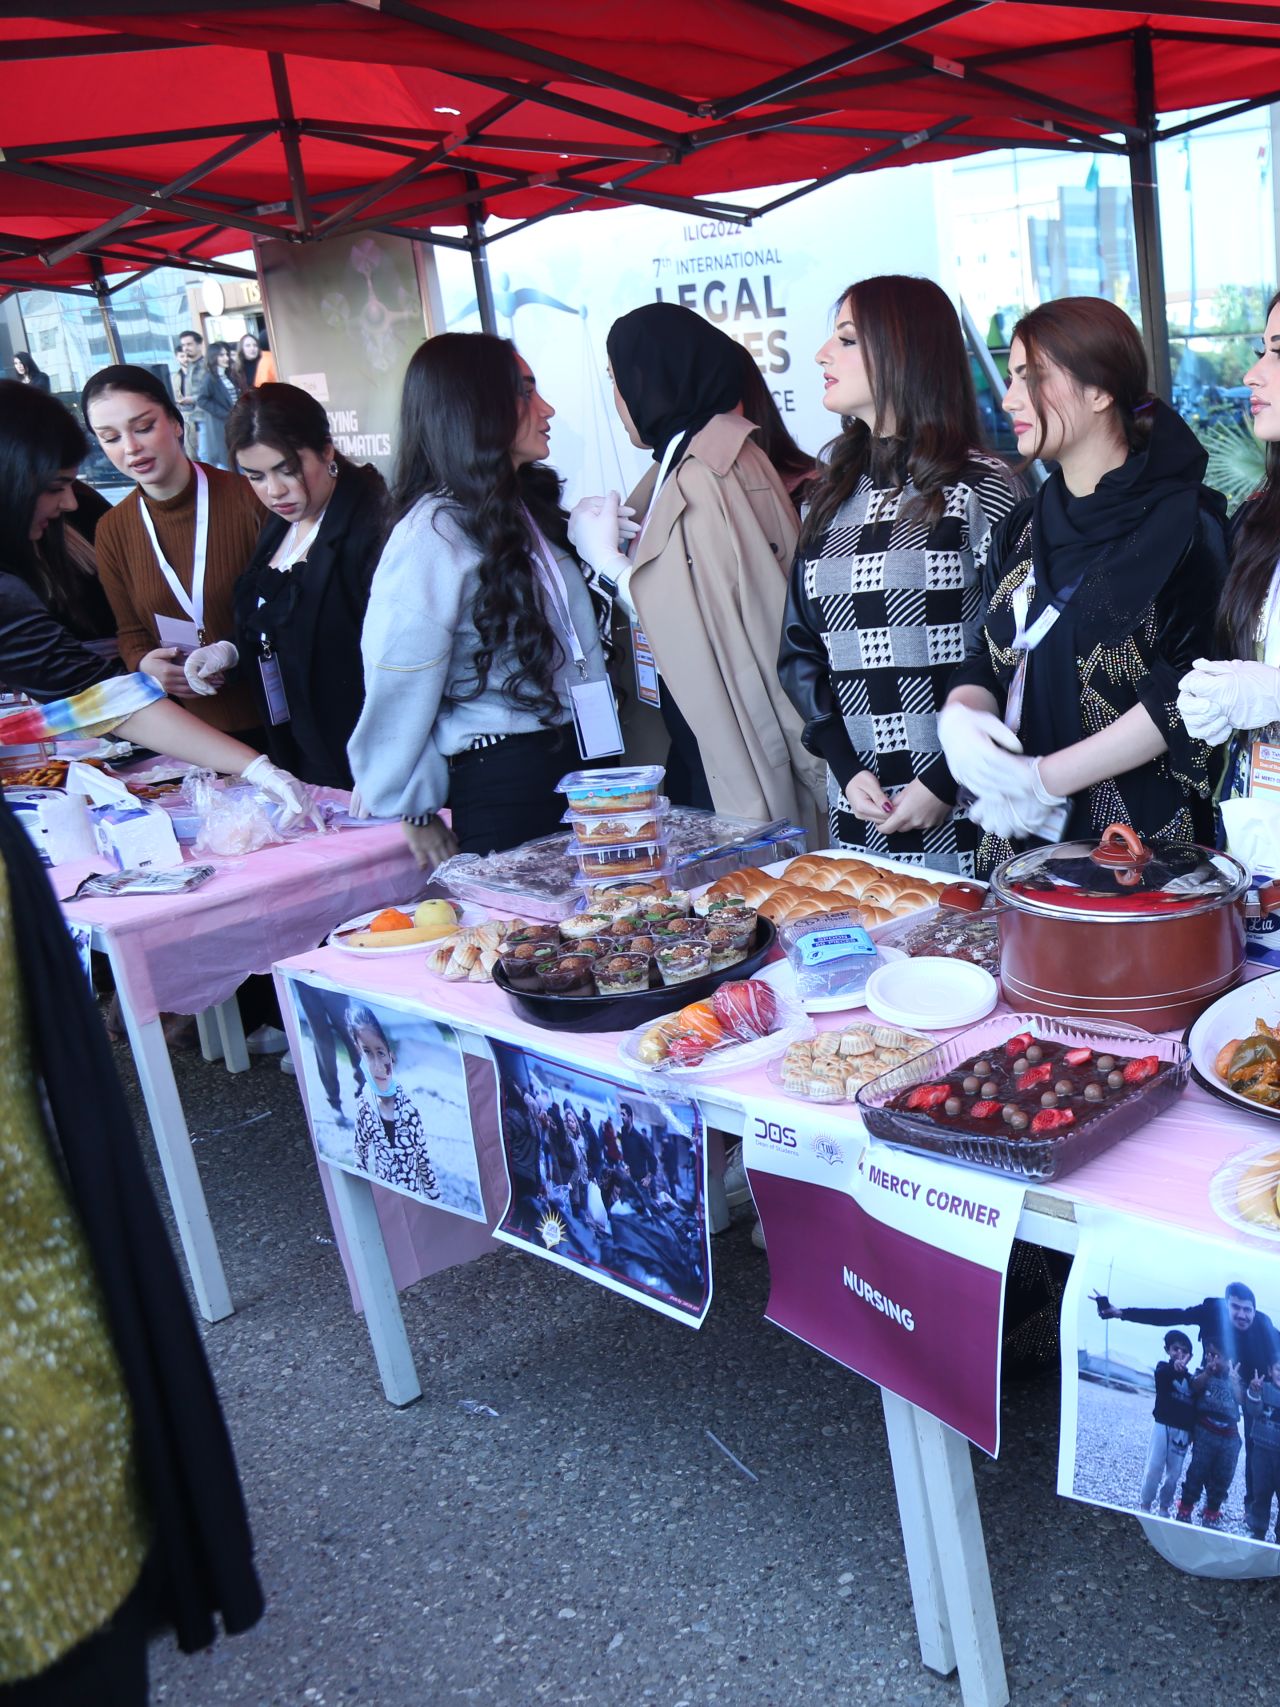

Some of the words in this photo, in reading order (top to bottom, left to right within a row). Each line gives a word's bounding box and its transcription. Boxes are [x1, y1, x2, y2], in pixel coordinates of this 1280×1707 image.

[683, 220, 743, 241] ILIC2022
[653, 256, 672, 278] 7th
[676, 248, 782, 275] INTERNATIONAL
[1249, 917, 1275, 931] Lia
[755, 1139, 769, 1147] Dean
[775, 1145, 800, 1157] Students
[869, 1165, 922, 1201] MERCY
[925, 1188, 1001, 1229] CORNER
[843, 1265, 915, 1332] NURSING
